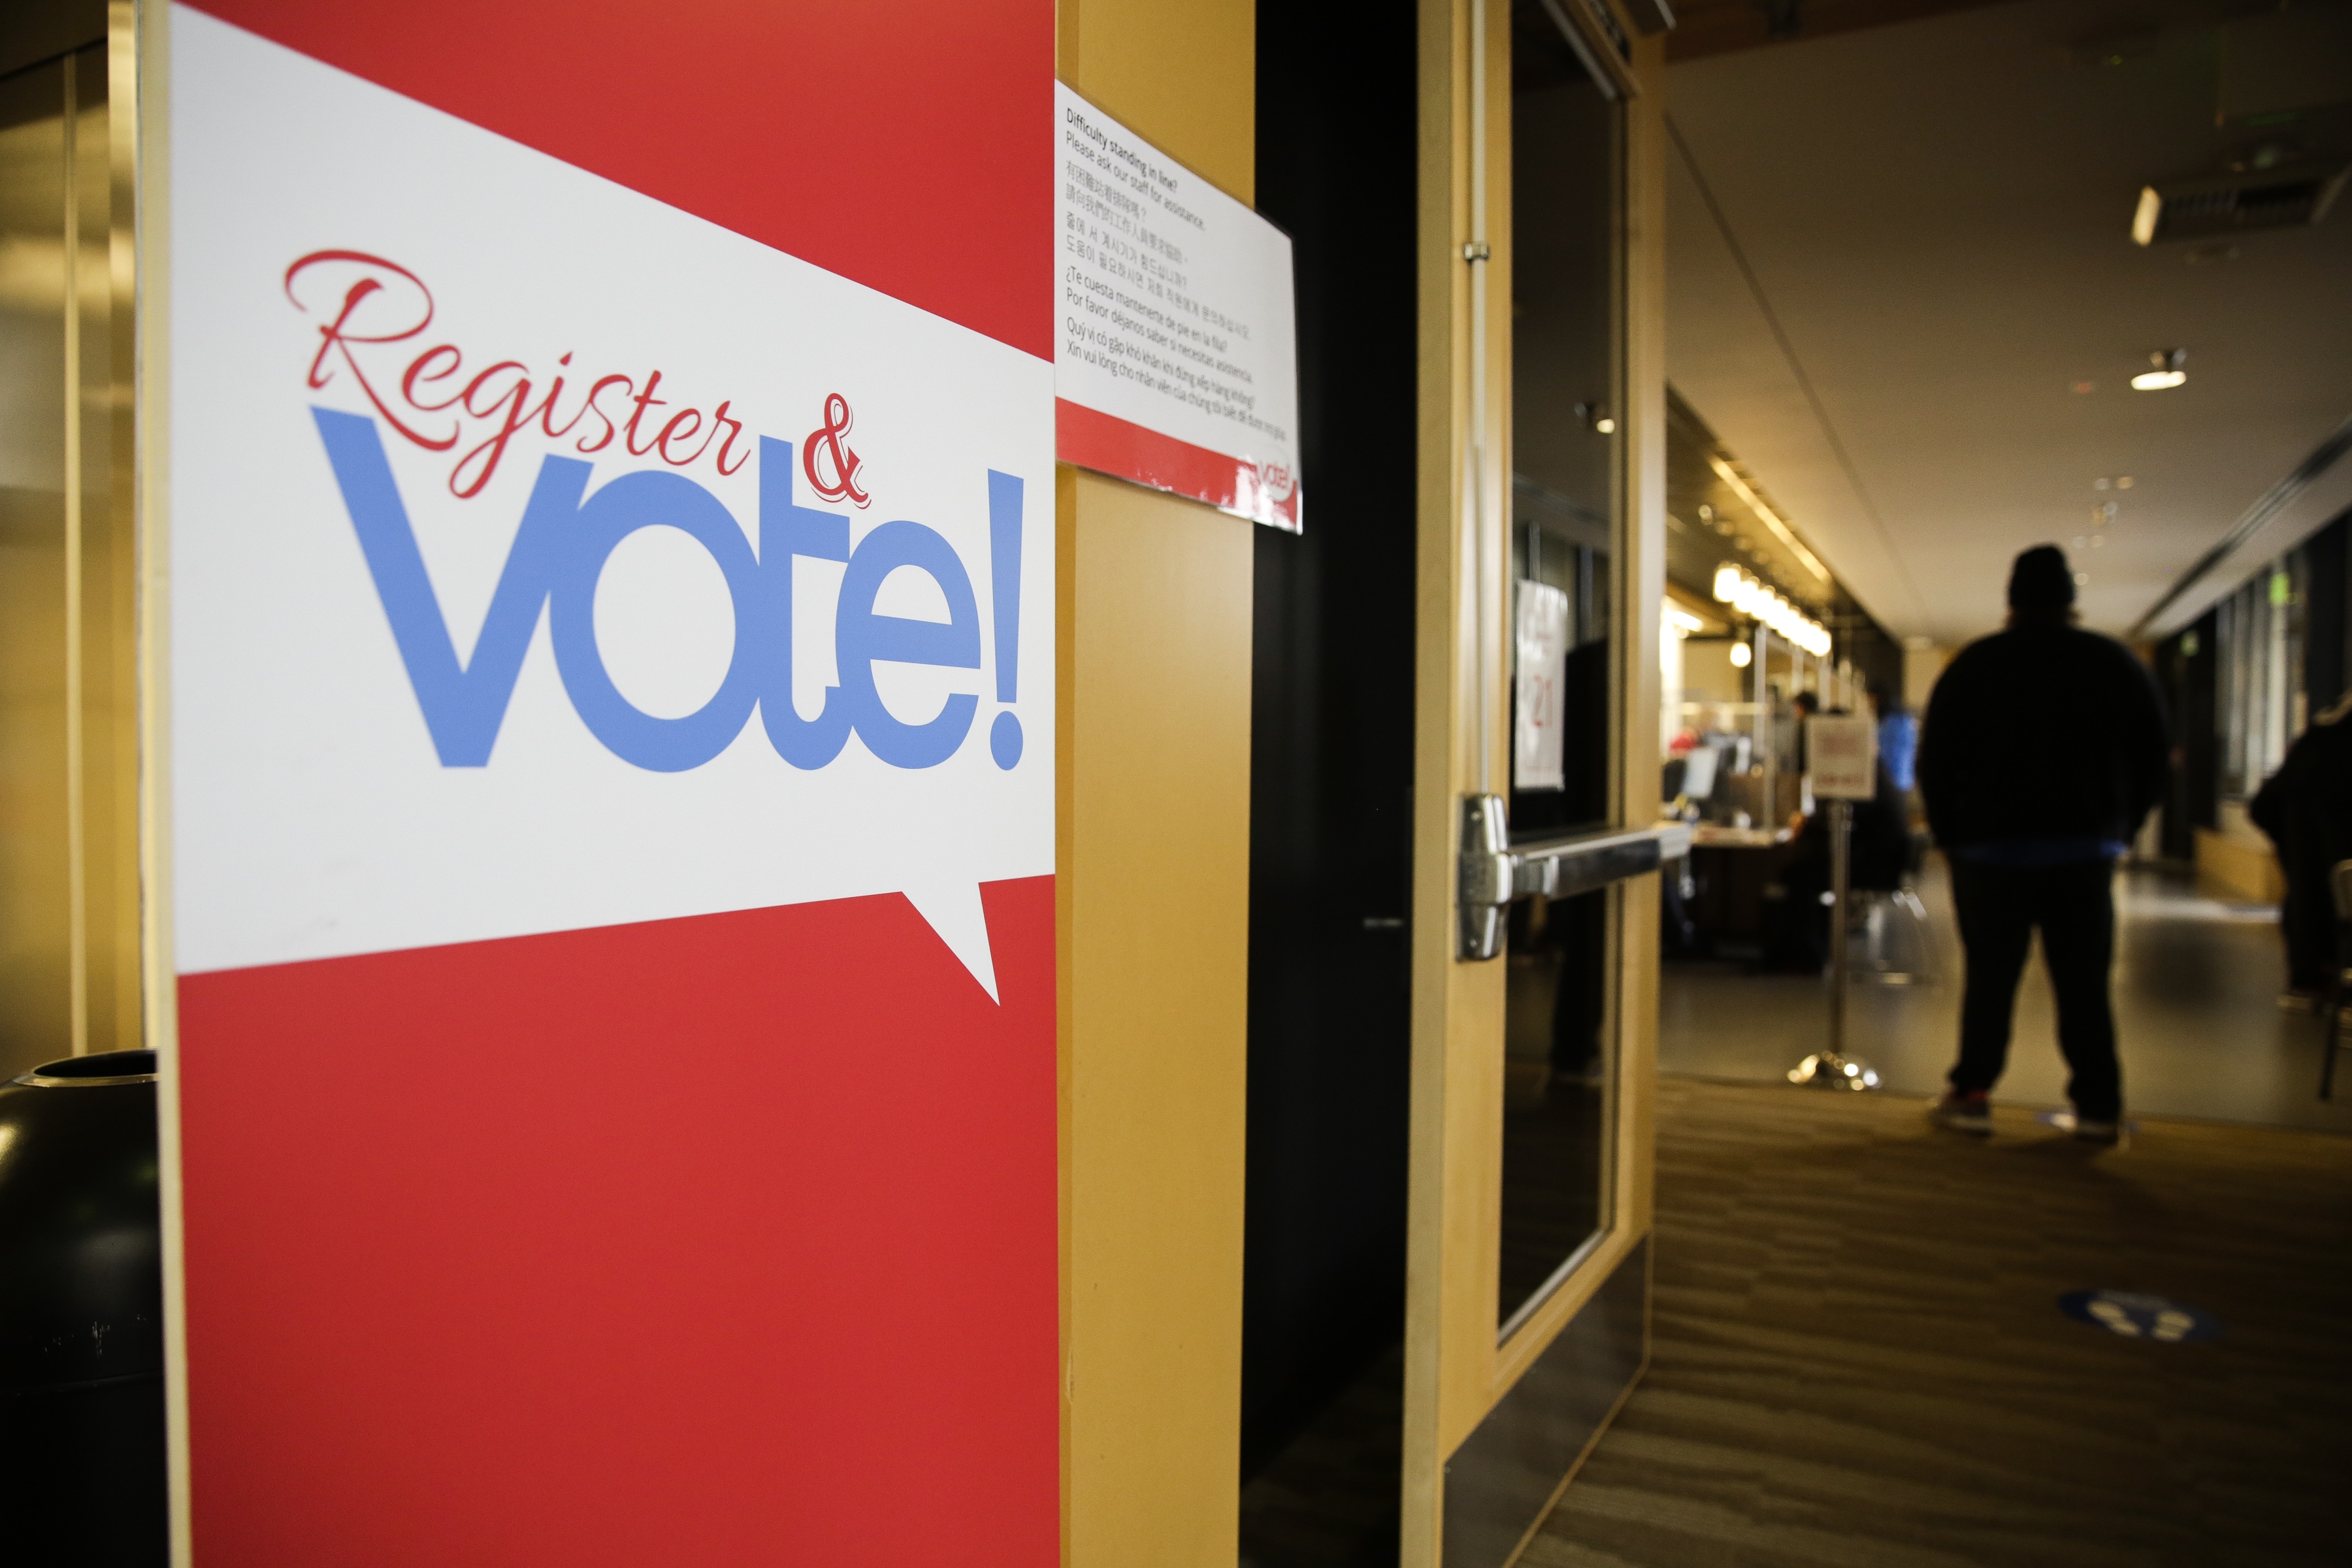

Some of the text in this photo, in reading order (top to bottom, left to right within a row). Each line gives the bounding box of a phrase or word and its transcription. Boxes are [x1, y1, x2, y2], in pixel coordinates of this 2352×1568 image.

[1066, 130, 1095, 162] Please
[1096, 154, 1112, 173] ask
[1113, 165, 1128, 182] our
[1130, 176, 1149, 195] staff
[1150, 185, 1162, 204] for
[1067, 107, 1178, 193] Difficulty standing in line?
[1066, 265, 1082, 285] ¿Te
[1084, 276, 1114, 300] cuesta
[1116, 291, 1164, 325] mantenerte
[1165, 315, 1175, 331] de
[1177, 321, 1190, 340] pie
[1067, 286, 1083, 306] Por
[1085, 295, 1109, 319] favor
[1146, 327, 1168, 347] saber
[1067, 316, 1086, 341] Quý
[285, 249, 872, 509] Register &
[1067, 339, 1081, 358] Xin
[1083, 350, 1097, 365] vui
[1119, 361, 1134, 380] cho
